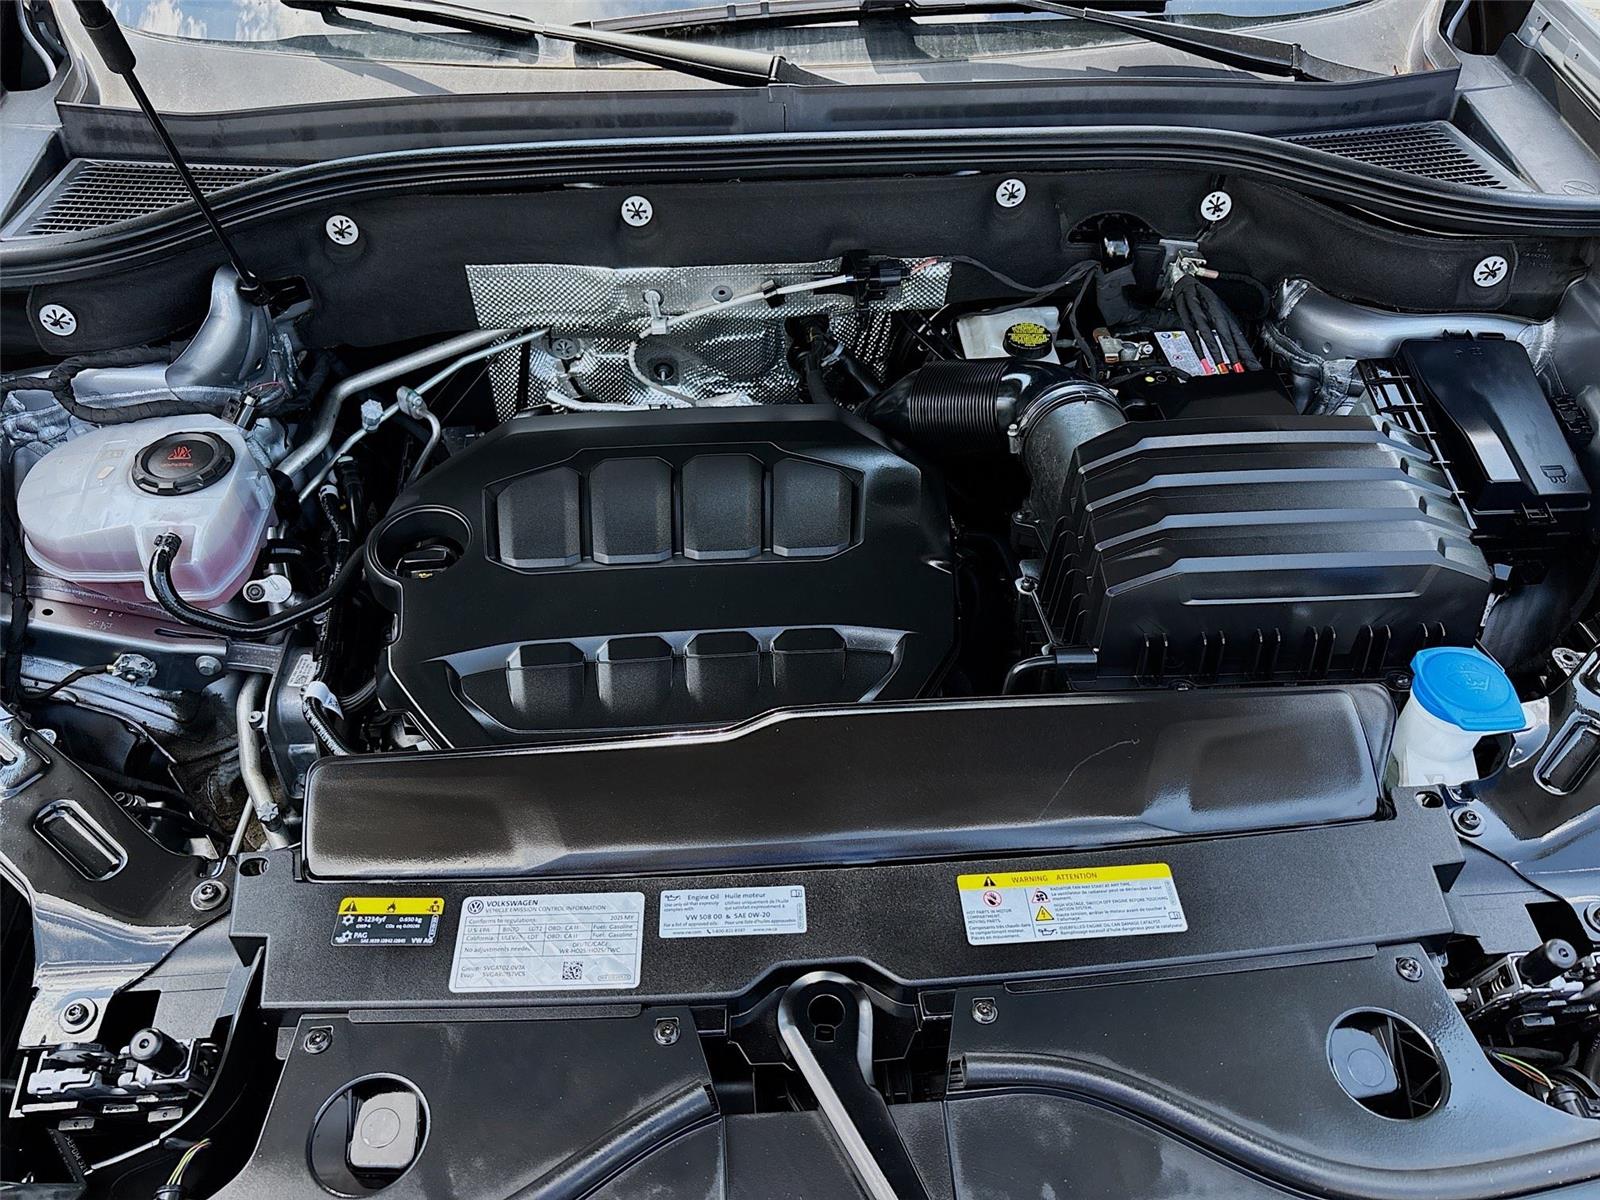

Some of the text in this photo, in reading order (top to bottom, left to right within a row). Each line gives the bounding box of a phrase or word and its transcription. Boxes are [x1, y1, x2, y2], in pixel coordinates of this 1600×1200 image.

[1011, 872, 1097, 884] WARNING ATTENTION
[486, 899, 539, 907] VOLKSWAGEN
[357, 916, 387, 924] R-1234yf
